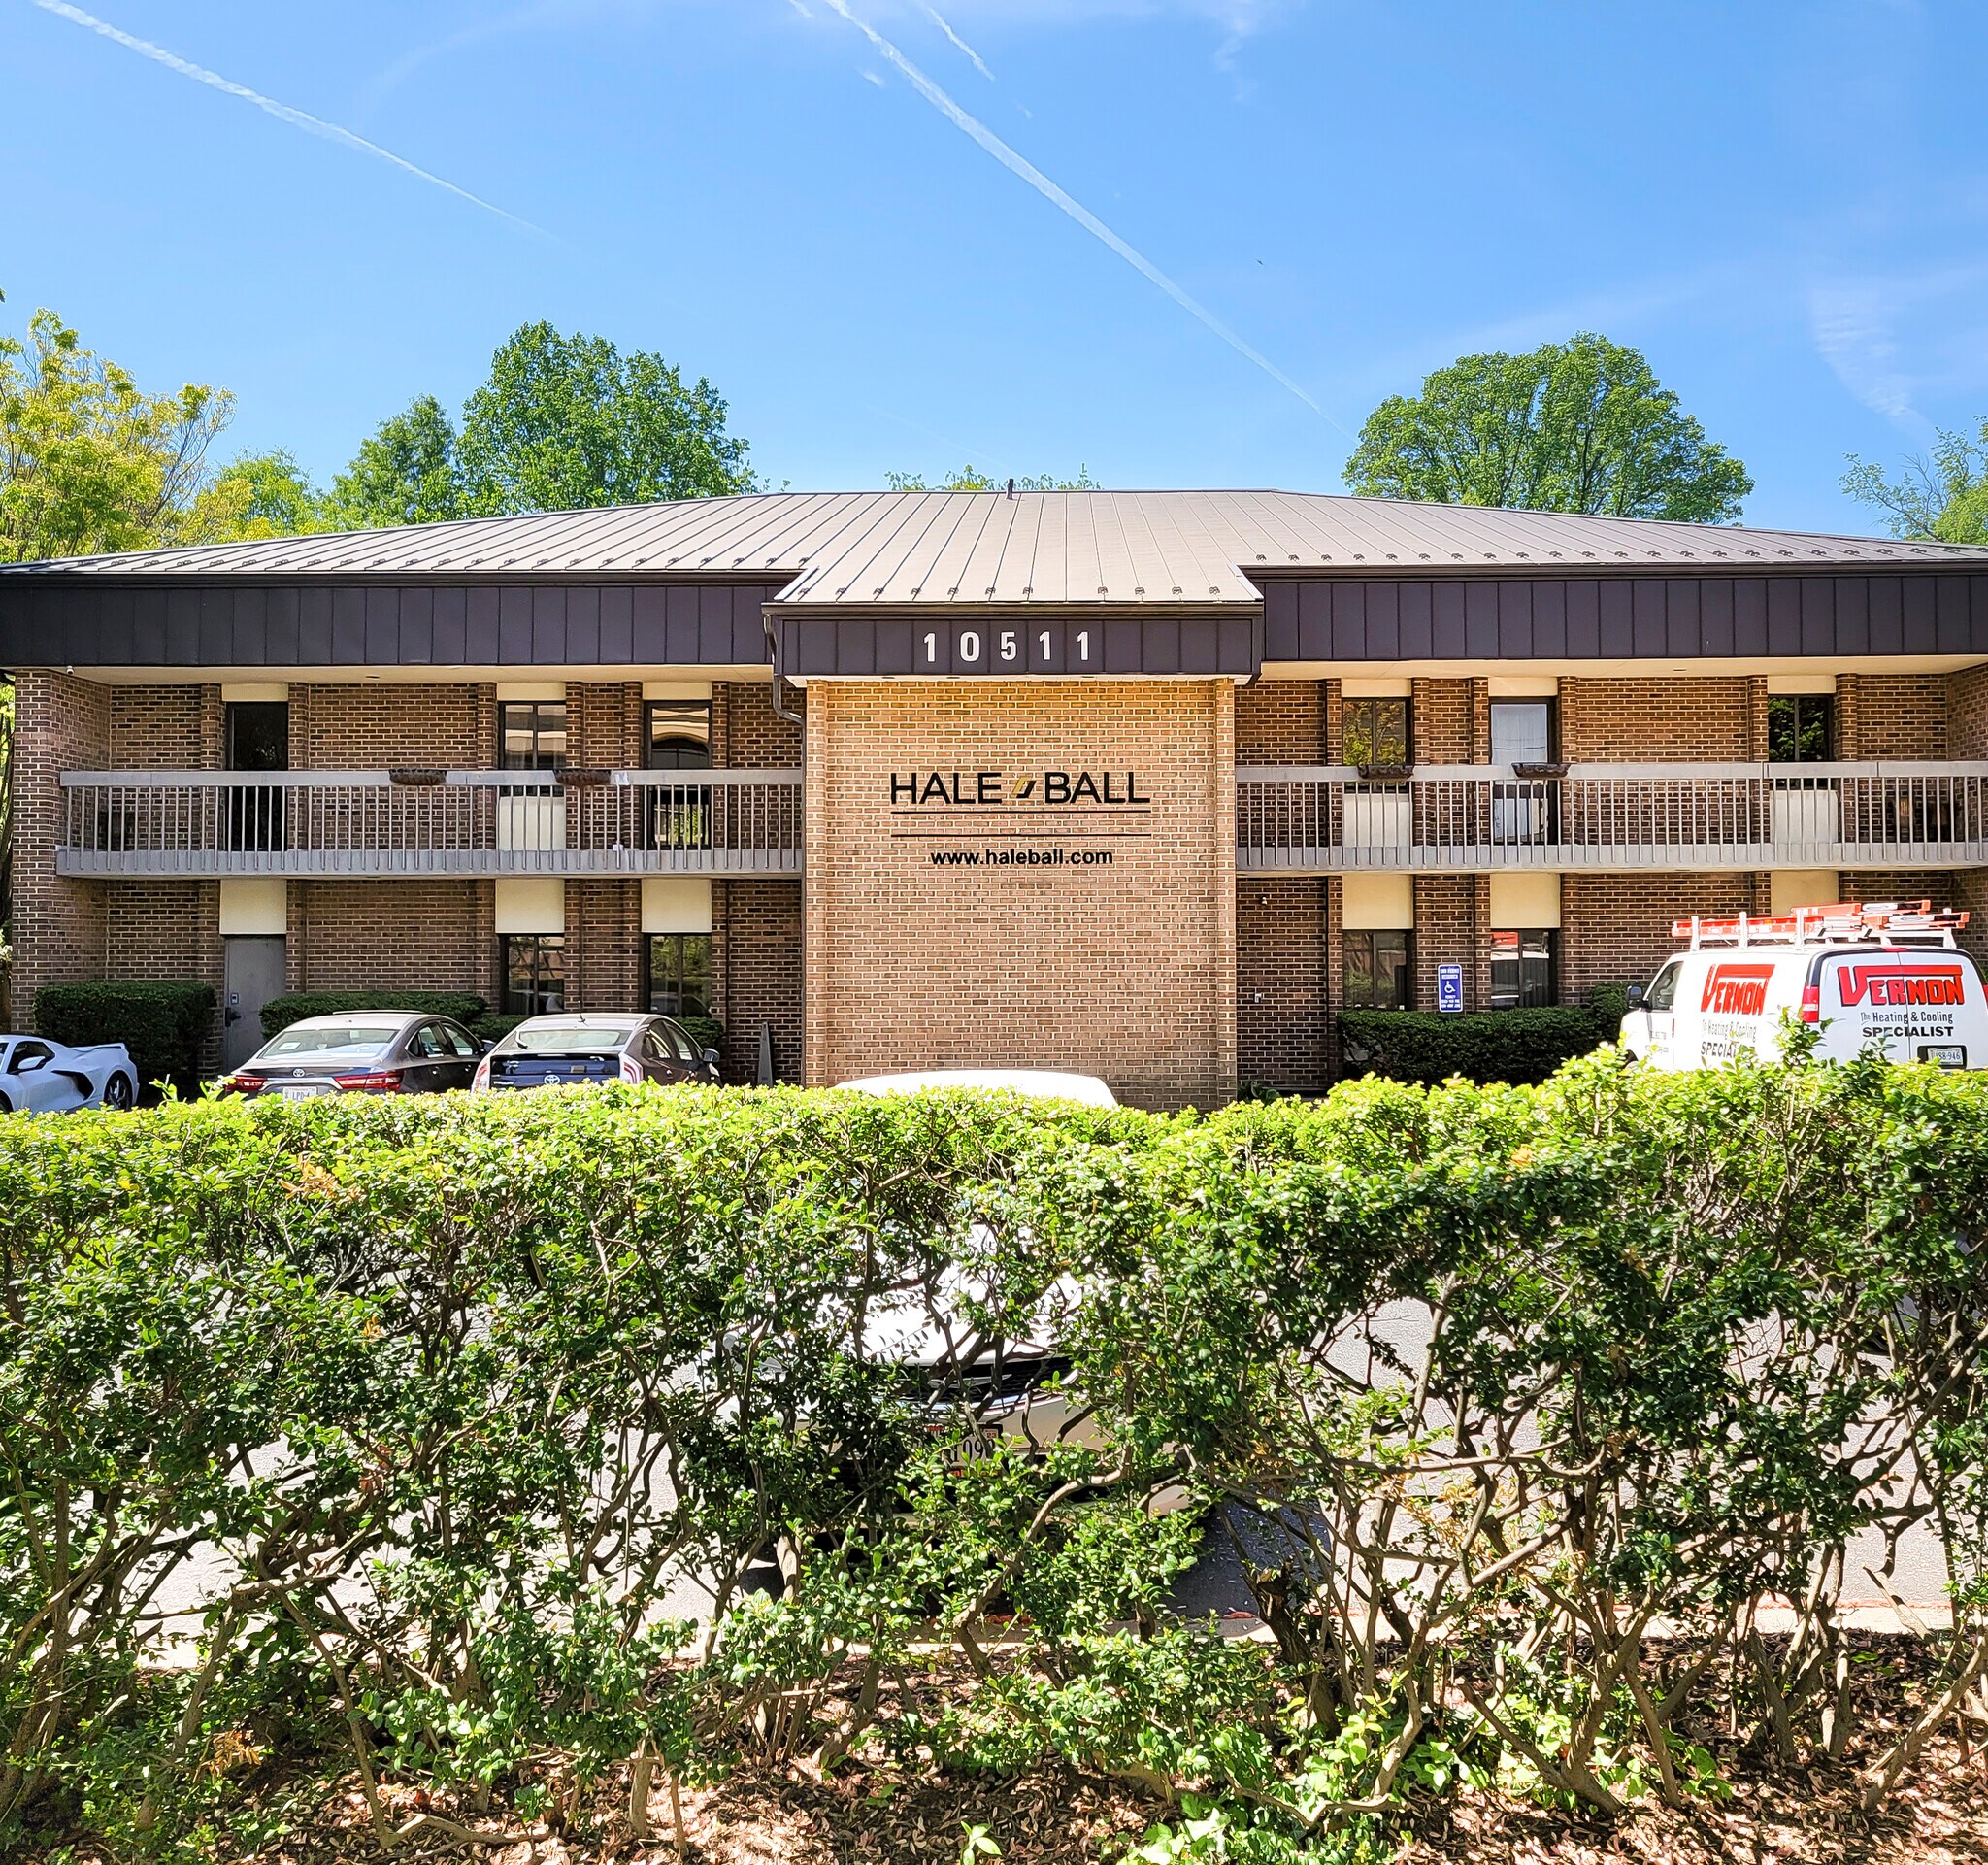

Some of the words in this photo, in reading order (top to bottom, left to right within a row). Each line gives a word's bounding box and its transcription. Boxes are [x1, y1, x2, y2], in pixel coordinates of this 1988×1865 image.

[923, 631, 1091, 662] 10511
[890, 772, 1003, 805] HALE
[1044, 771, 1151, 804] BALL
[930, 849, 1113, 865] www.haleball.com
[1700, 963, 1776, 1016] VERNON
[1837, 964, 1966, 1008] VERNON
[1862, 1026, 1954, 1038] SPECIALIST
[1872, 1012, 1908, 1025] Heating
[1910, 1013, 1919, 1022] &
[1920, 1012, 1953, 1024] Cooling
